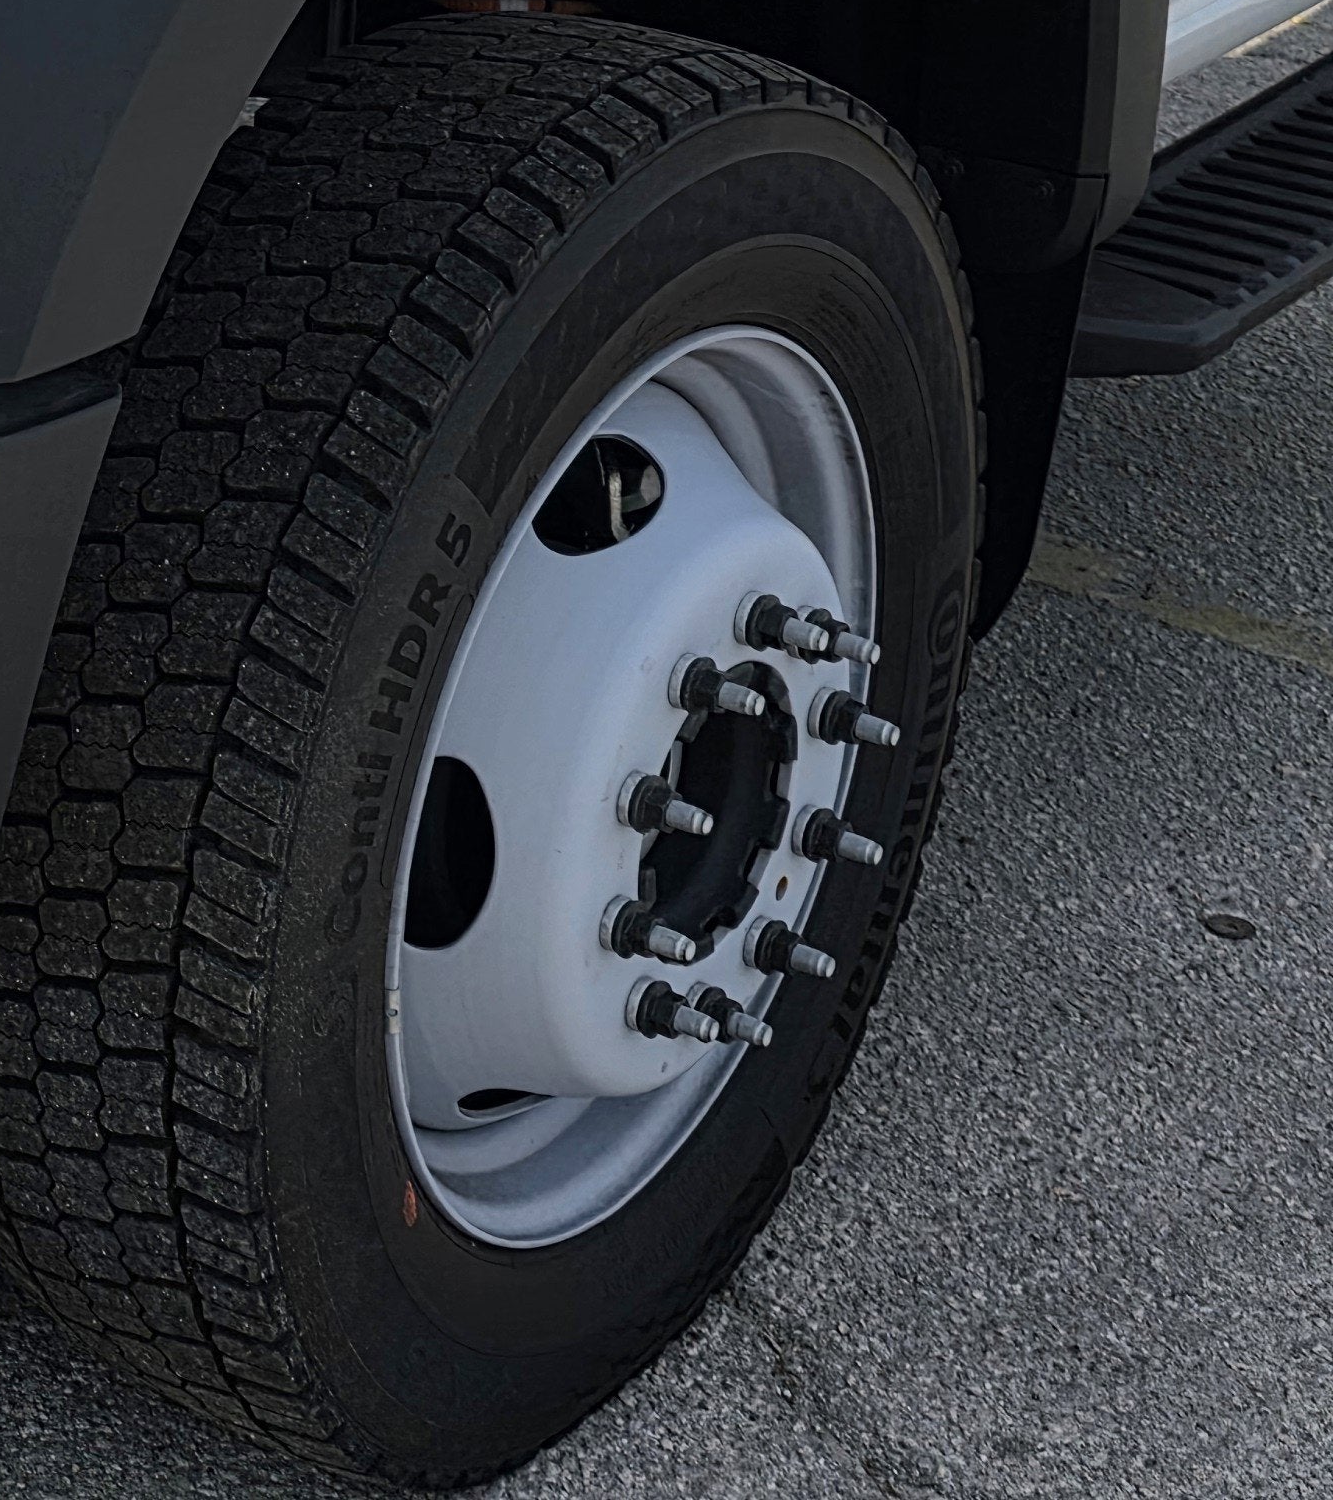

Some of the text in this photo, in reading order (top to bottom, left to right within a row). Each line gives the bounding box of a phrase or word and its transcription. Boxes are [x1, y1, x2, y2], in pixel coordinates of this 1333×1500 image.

[323, 512, 472, 946] Conti HDR 5
